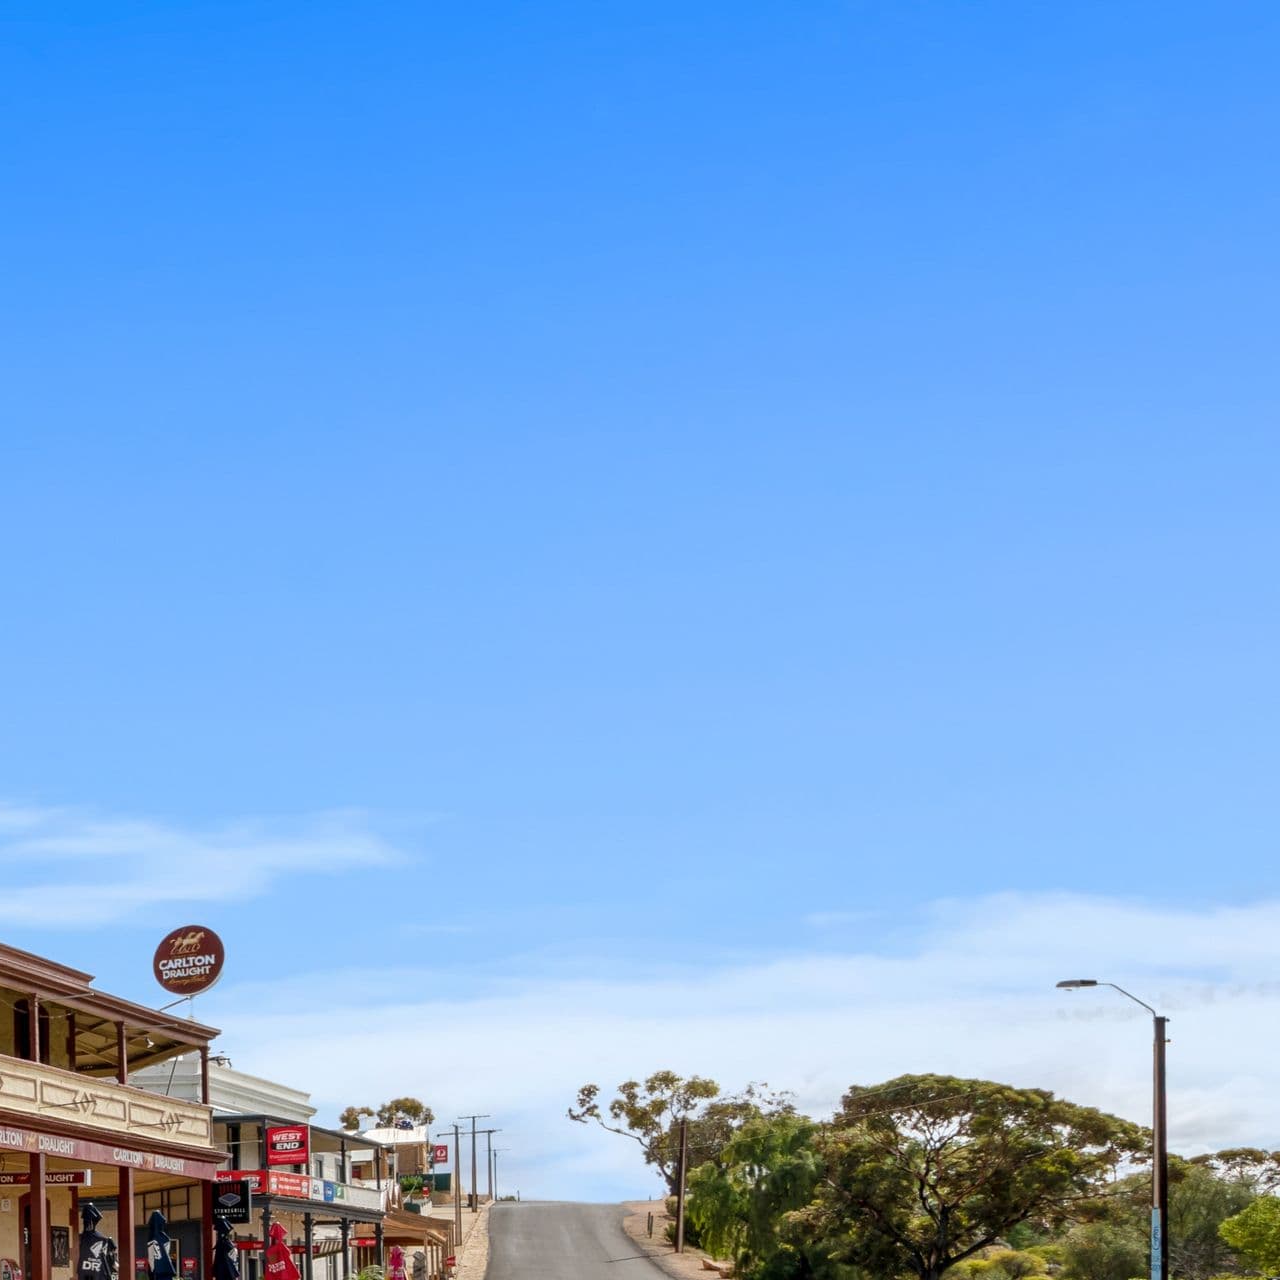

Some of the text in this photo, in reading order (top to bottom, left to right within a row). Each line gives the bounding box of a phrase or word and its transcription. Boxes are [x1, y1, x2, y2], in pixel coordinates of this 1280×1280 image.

[158, 954, 216, 971] CARLTON
[162, 965, 211, 979] DRAUGHT
[272, 1132, 303, 1142] WEST
[38, 1135, 75, 1154] DRAUGHT
[275, 1142, 300, 1151] END
[113, 1148, 185, 1172] CARLTON DRAUGHT
[44, 1173, 75, 1183] AUGHT
